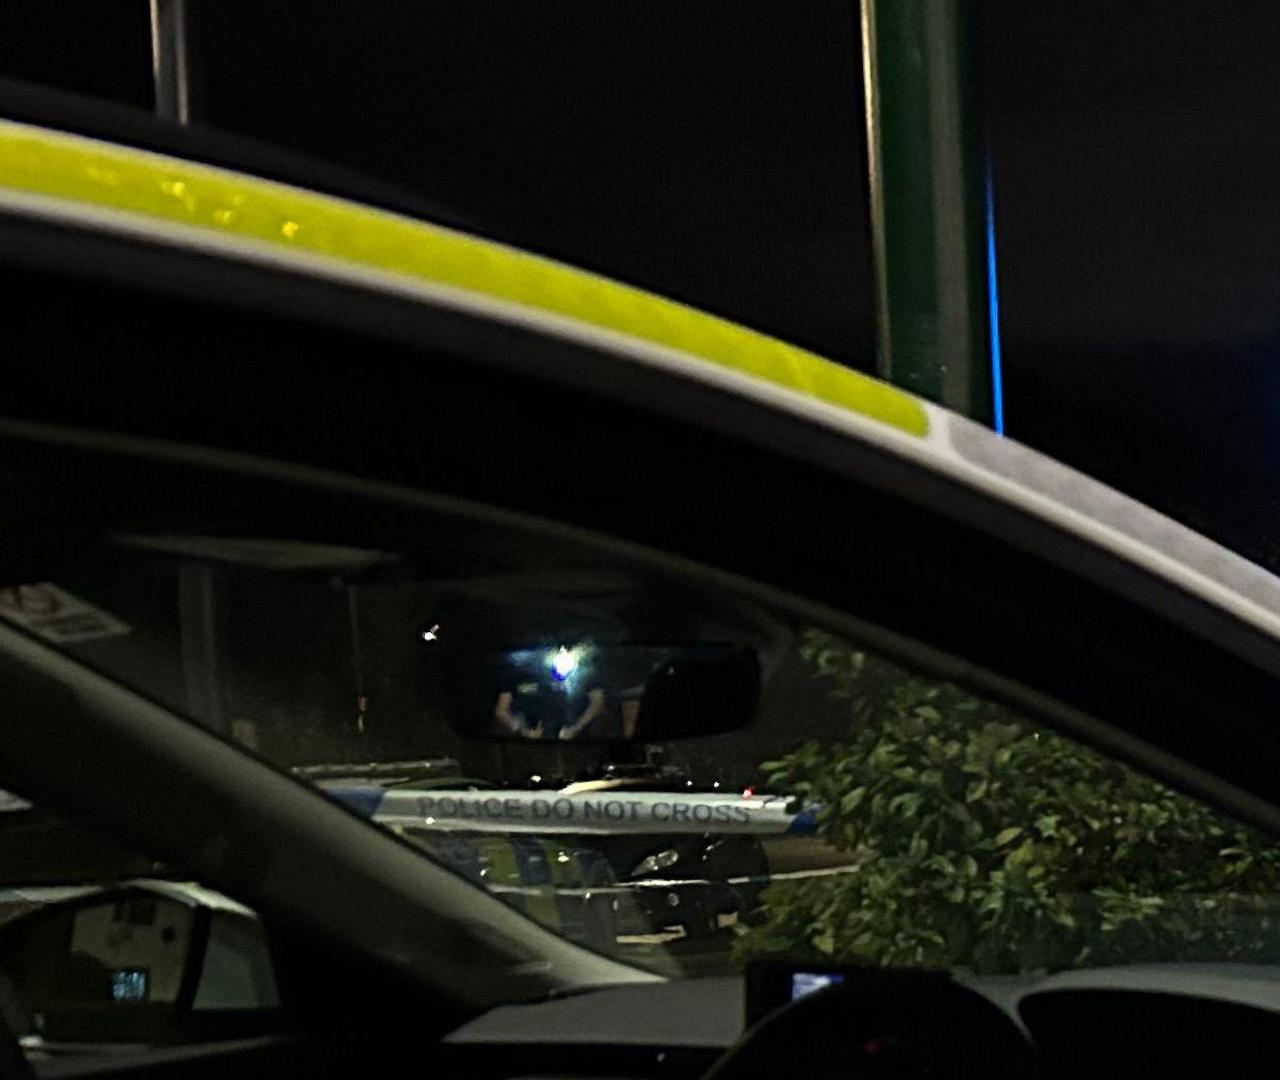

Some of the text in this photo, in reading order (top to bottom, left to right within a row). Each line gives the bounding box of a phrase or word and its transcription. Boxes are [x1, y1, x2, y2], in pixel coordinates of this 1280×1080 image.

[418, 796, 750, 825] POLICE DO NOT CROSS
